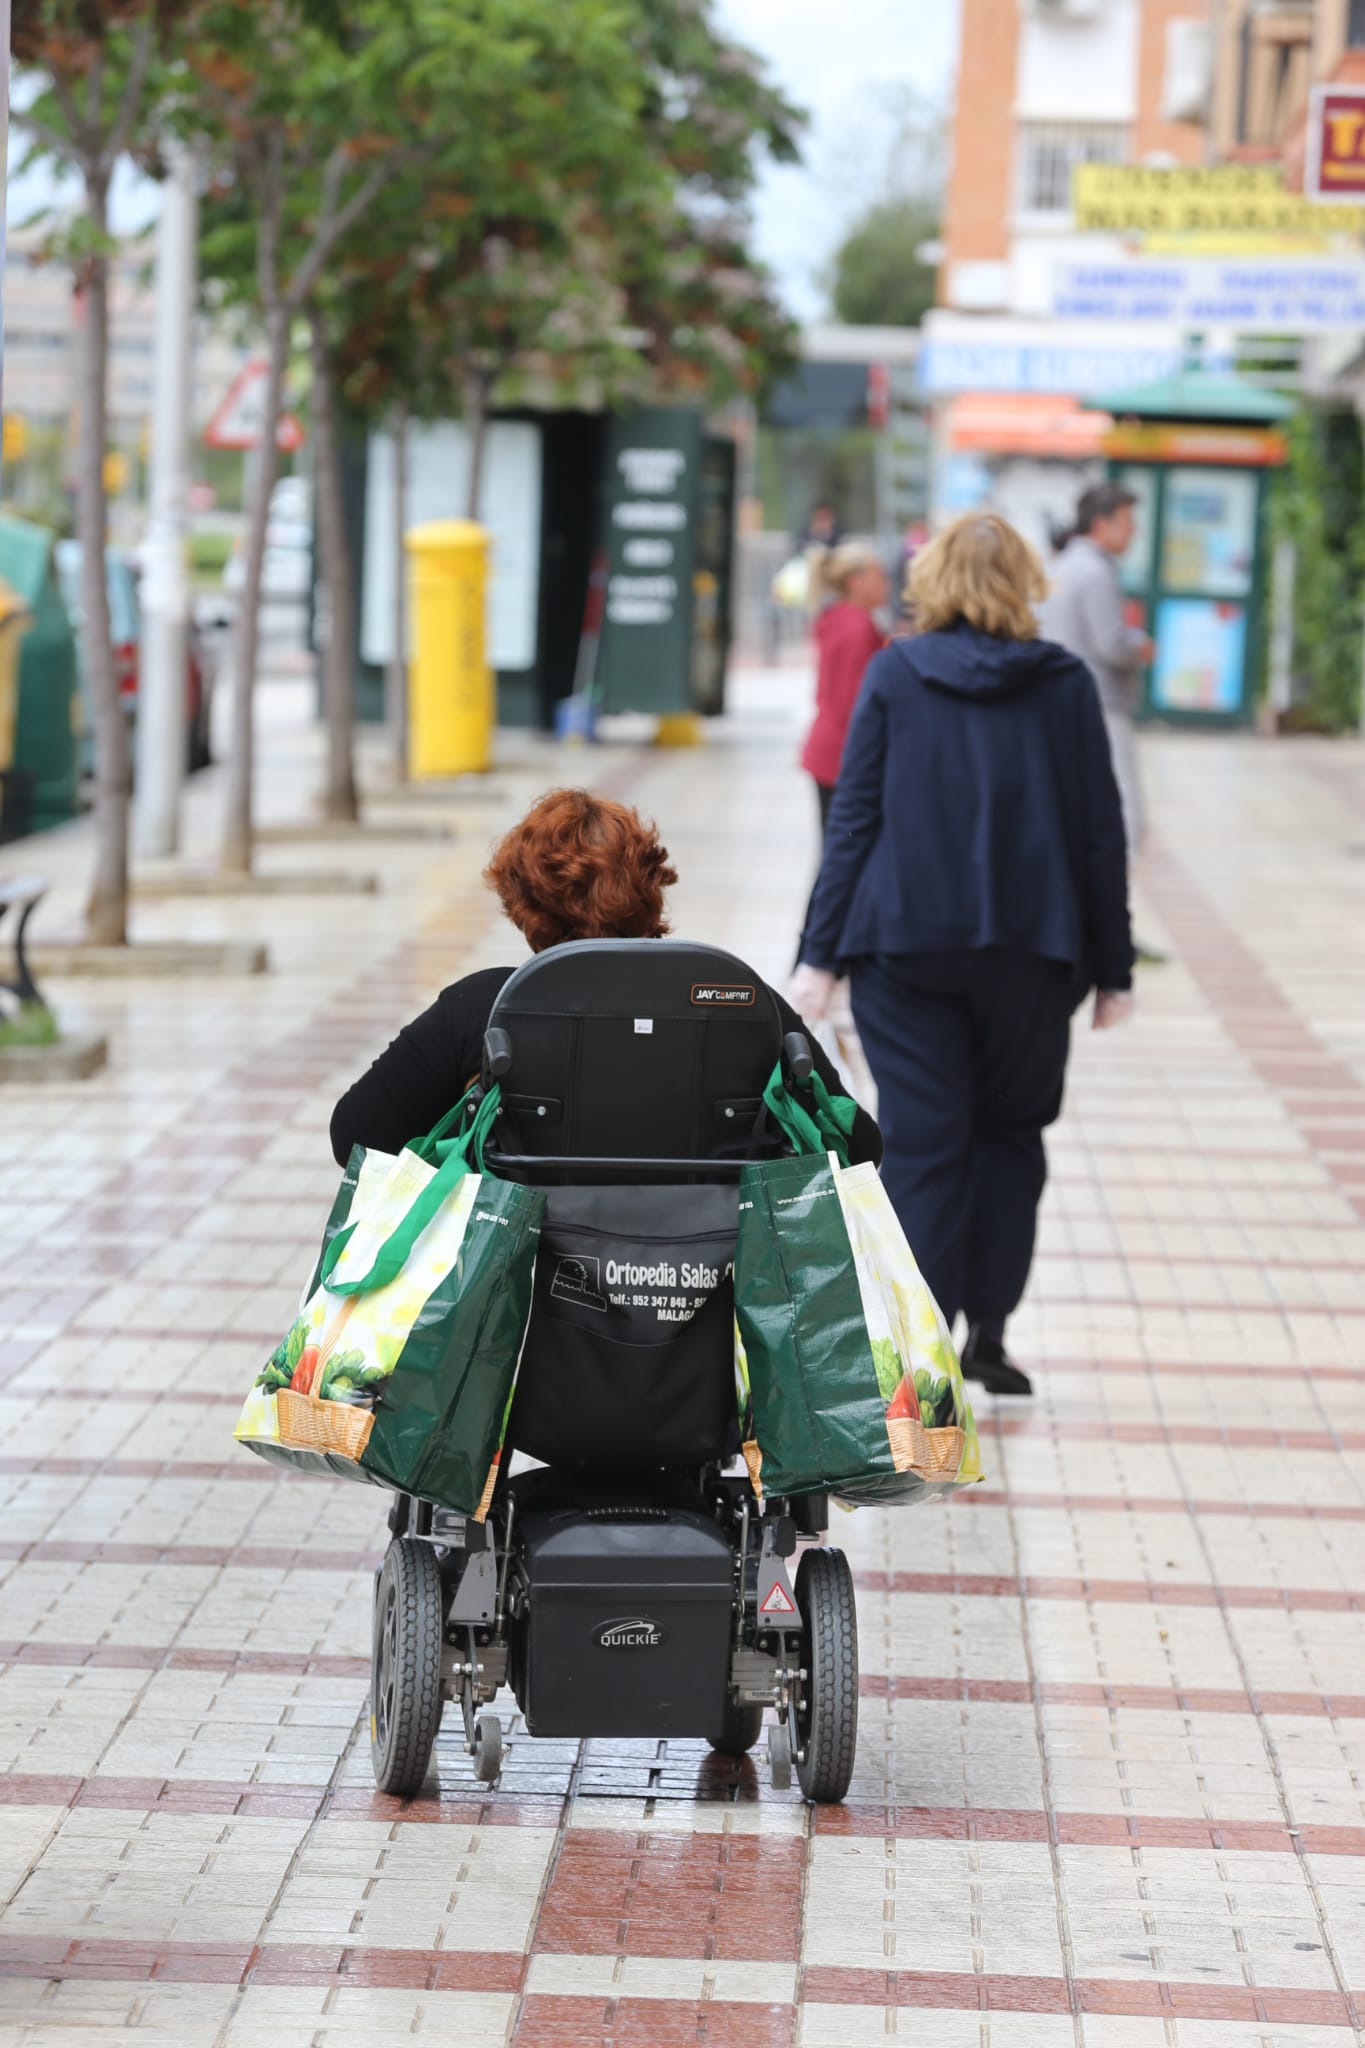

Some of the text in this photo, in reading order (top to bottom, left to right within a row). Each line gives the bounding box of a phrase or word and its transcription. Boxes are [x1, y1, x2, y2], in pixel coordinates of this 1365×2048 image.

[696, 990, 751, 1000] JAY COMFORT
[605, 1260, 677, 1287] Ortopedia
[680, 1262, 719, 1289] Salas
[632, 1294, 649, 1307] 952
[651, 1295, 668, 1308] 347
[600, 1633, 660, 1647] QUICKIE
